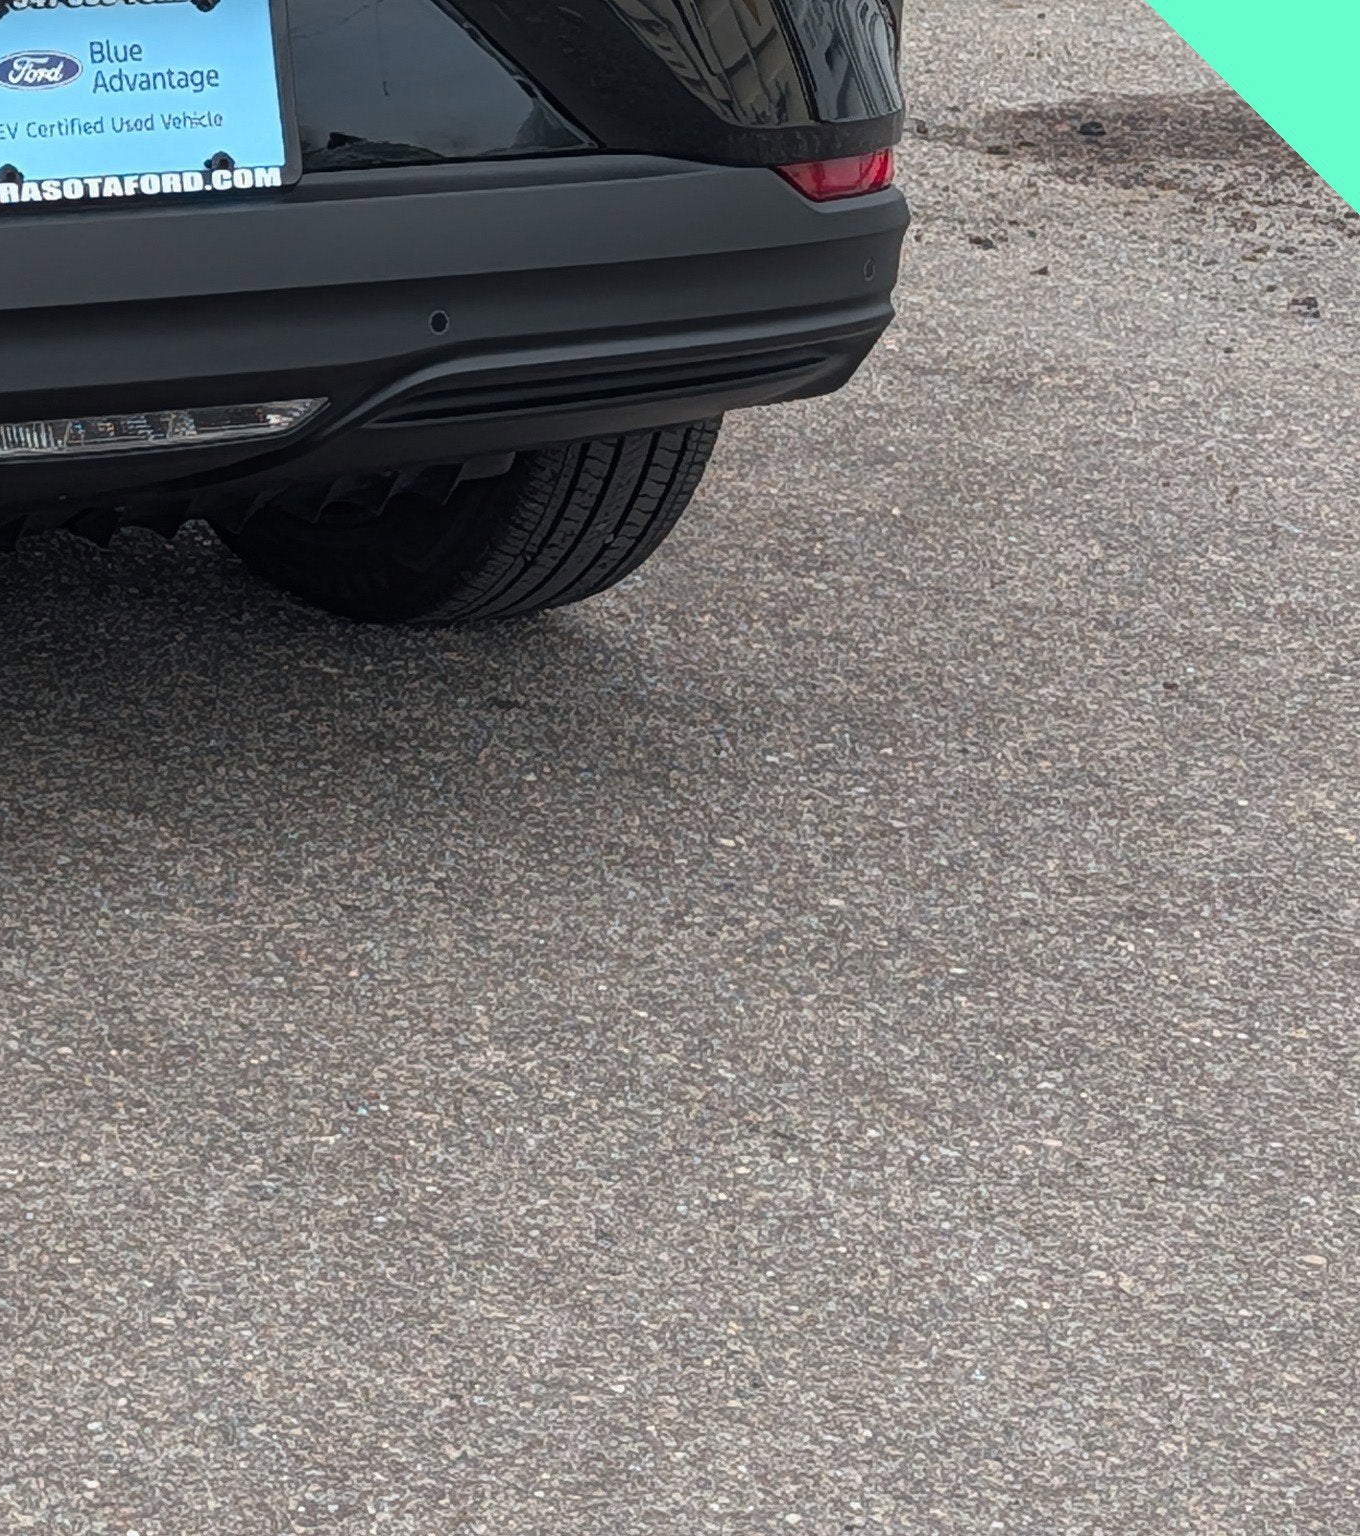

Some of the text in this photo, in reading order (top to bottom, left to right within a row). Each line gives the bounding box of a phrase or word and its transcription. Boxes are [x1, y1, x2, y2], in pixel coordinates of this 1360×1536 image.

[89, 40, 143, 64] Blue
[8, 56, 64, 84] Ford
[92, 68, 220, 94] Advantage
[26, 116, 105, 138] Certified
[111, 114, 155, 133] Used
[160, 110, 224, 131] Vehicle
